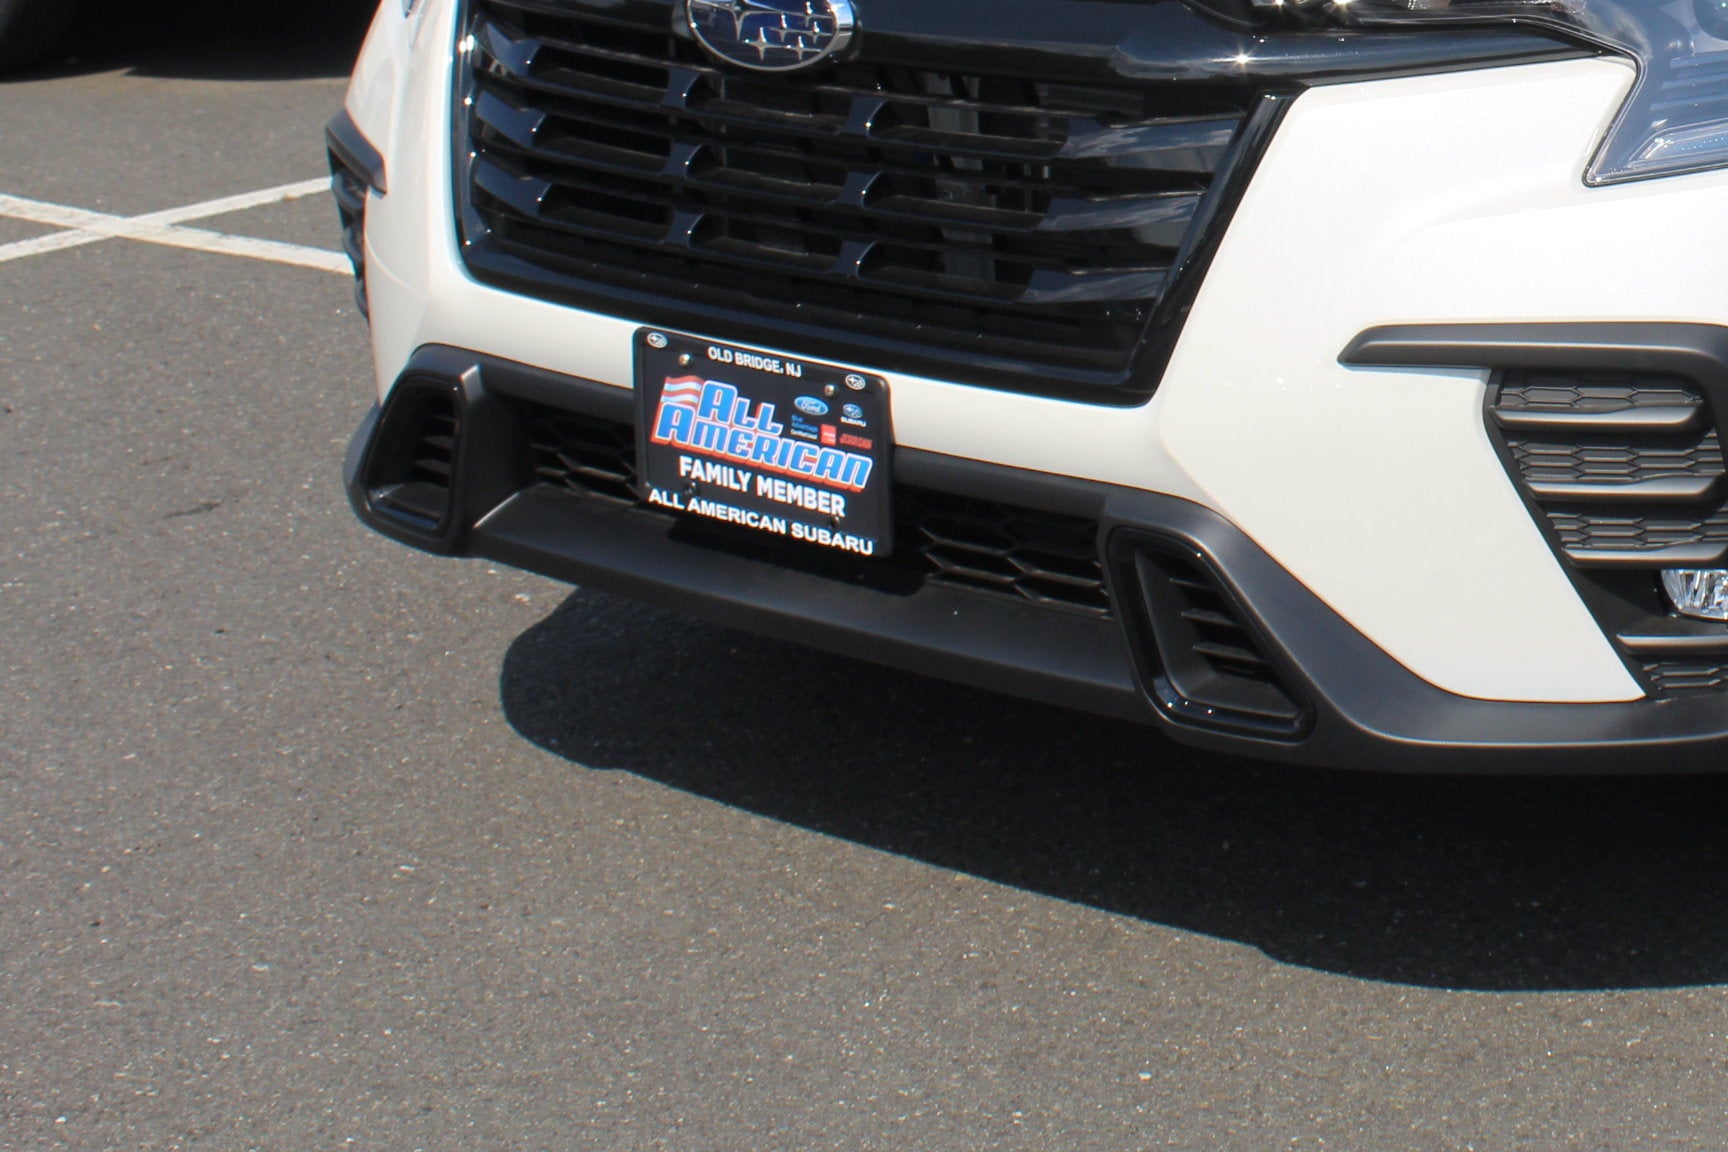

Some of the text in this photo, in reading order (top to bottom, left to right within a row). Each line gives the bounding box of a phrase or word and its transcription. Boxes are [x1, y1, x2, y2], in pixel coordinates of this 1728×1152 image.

[708, 346, 732, 364] OLD
[785, 362, 802, 378] NJ
[652, 402, 873, 491] AMERICAN
[679, 455, 846, 517] FAMILY MEMBER
[649, 488, 874, 556] ALL AMERICAN SUBARU
